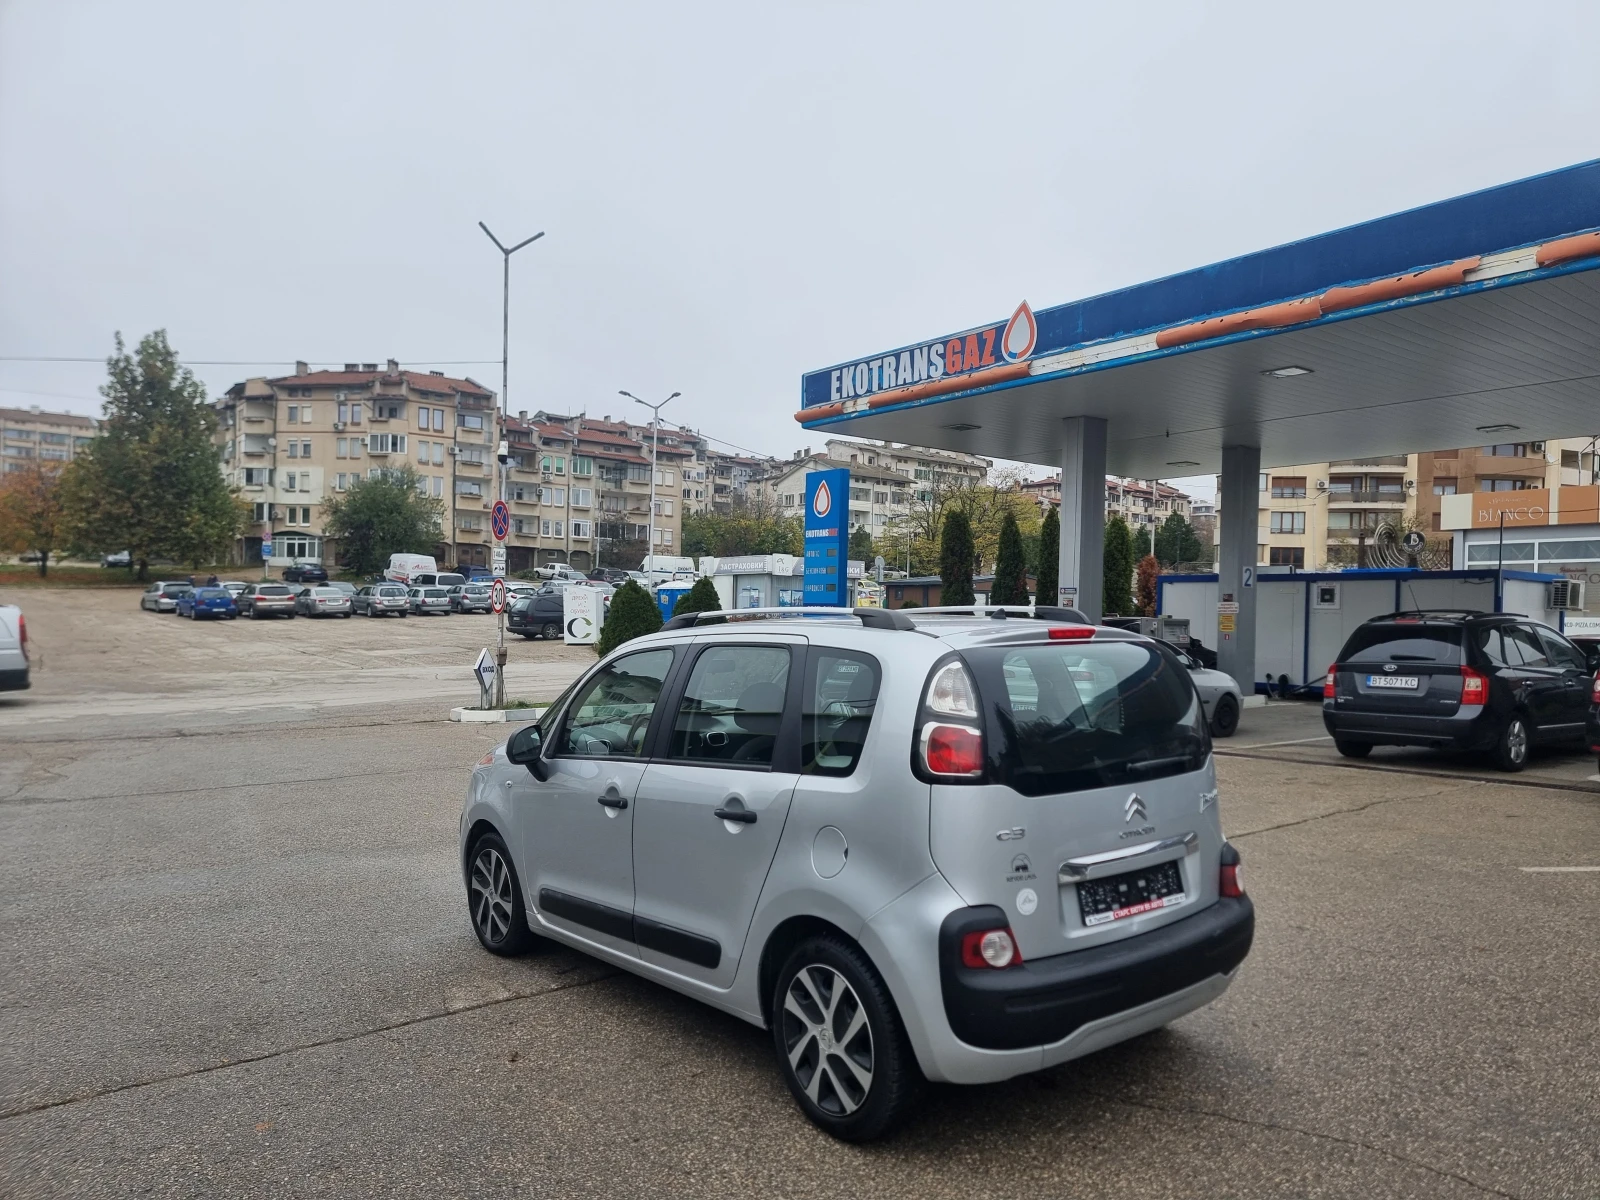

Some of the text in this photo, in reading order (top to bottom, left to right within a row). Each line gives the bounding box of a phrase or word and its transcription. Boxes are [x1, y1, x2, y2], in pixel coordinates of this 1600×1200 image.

[830, 329, 996, 401] EKOTRANSGAZ
[720, 562, 763, 570] ЗАСТРАХОВКИ
[1244, 568, 1252, 587] 2
[494, 588, 503, 605] 30
[482, 665, 494, 673] ВХОД
[996, 826, 1025, 841] C3
